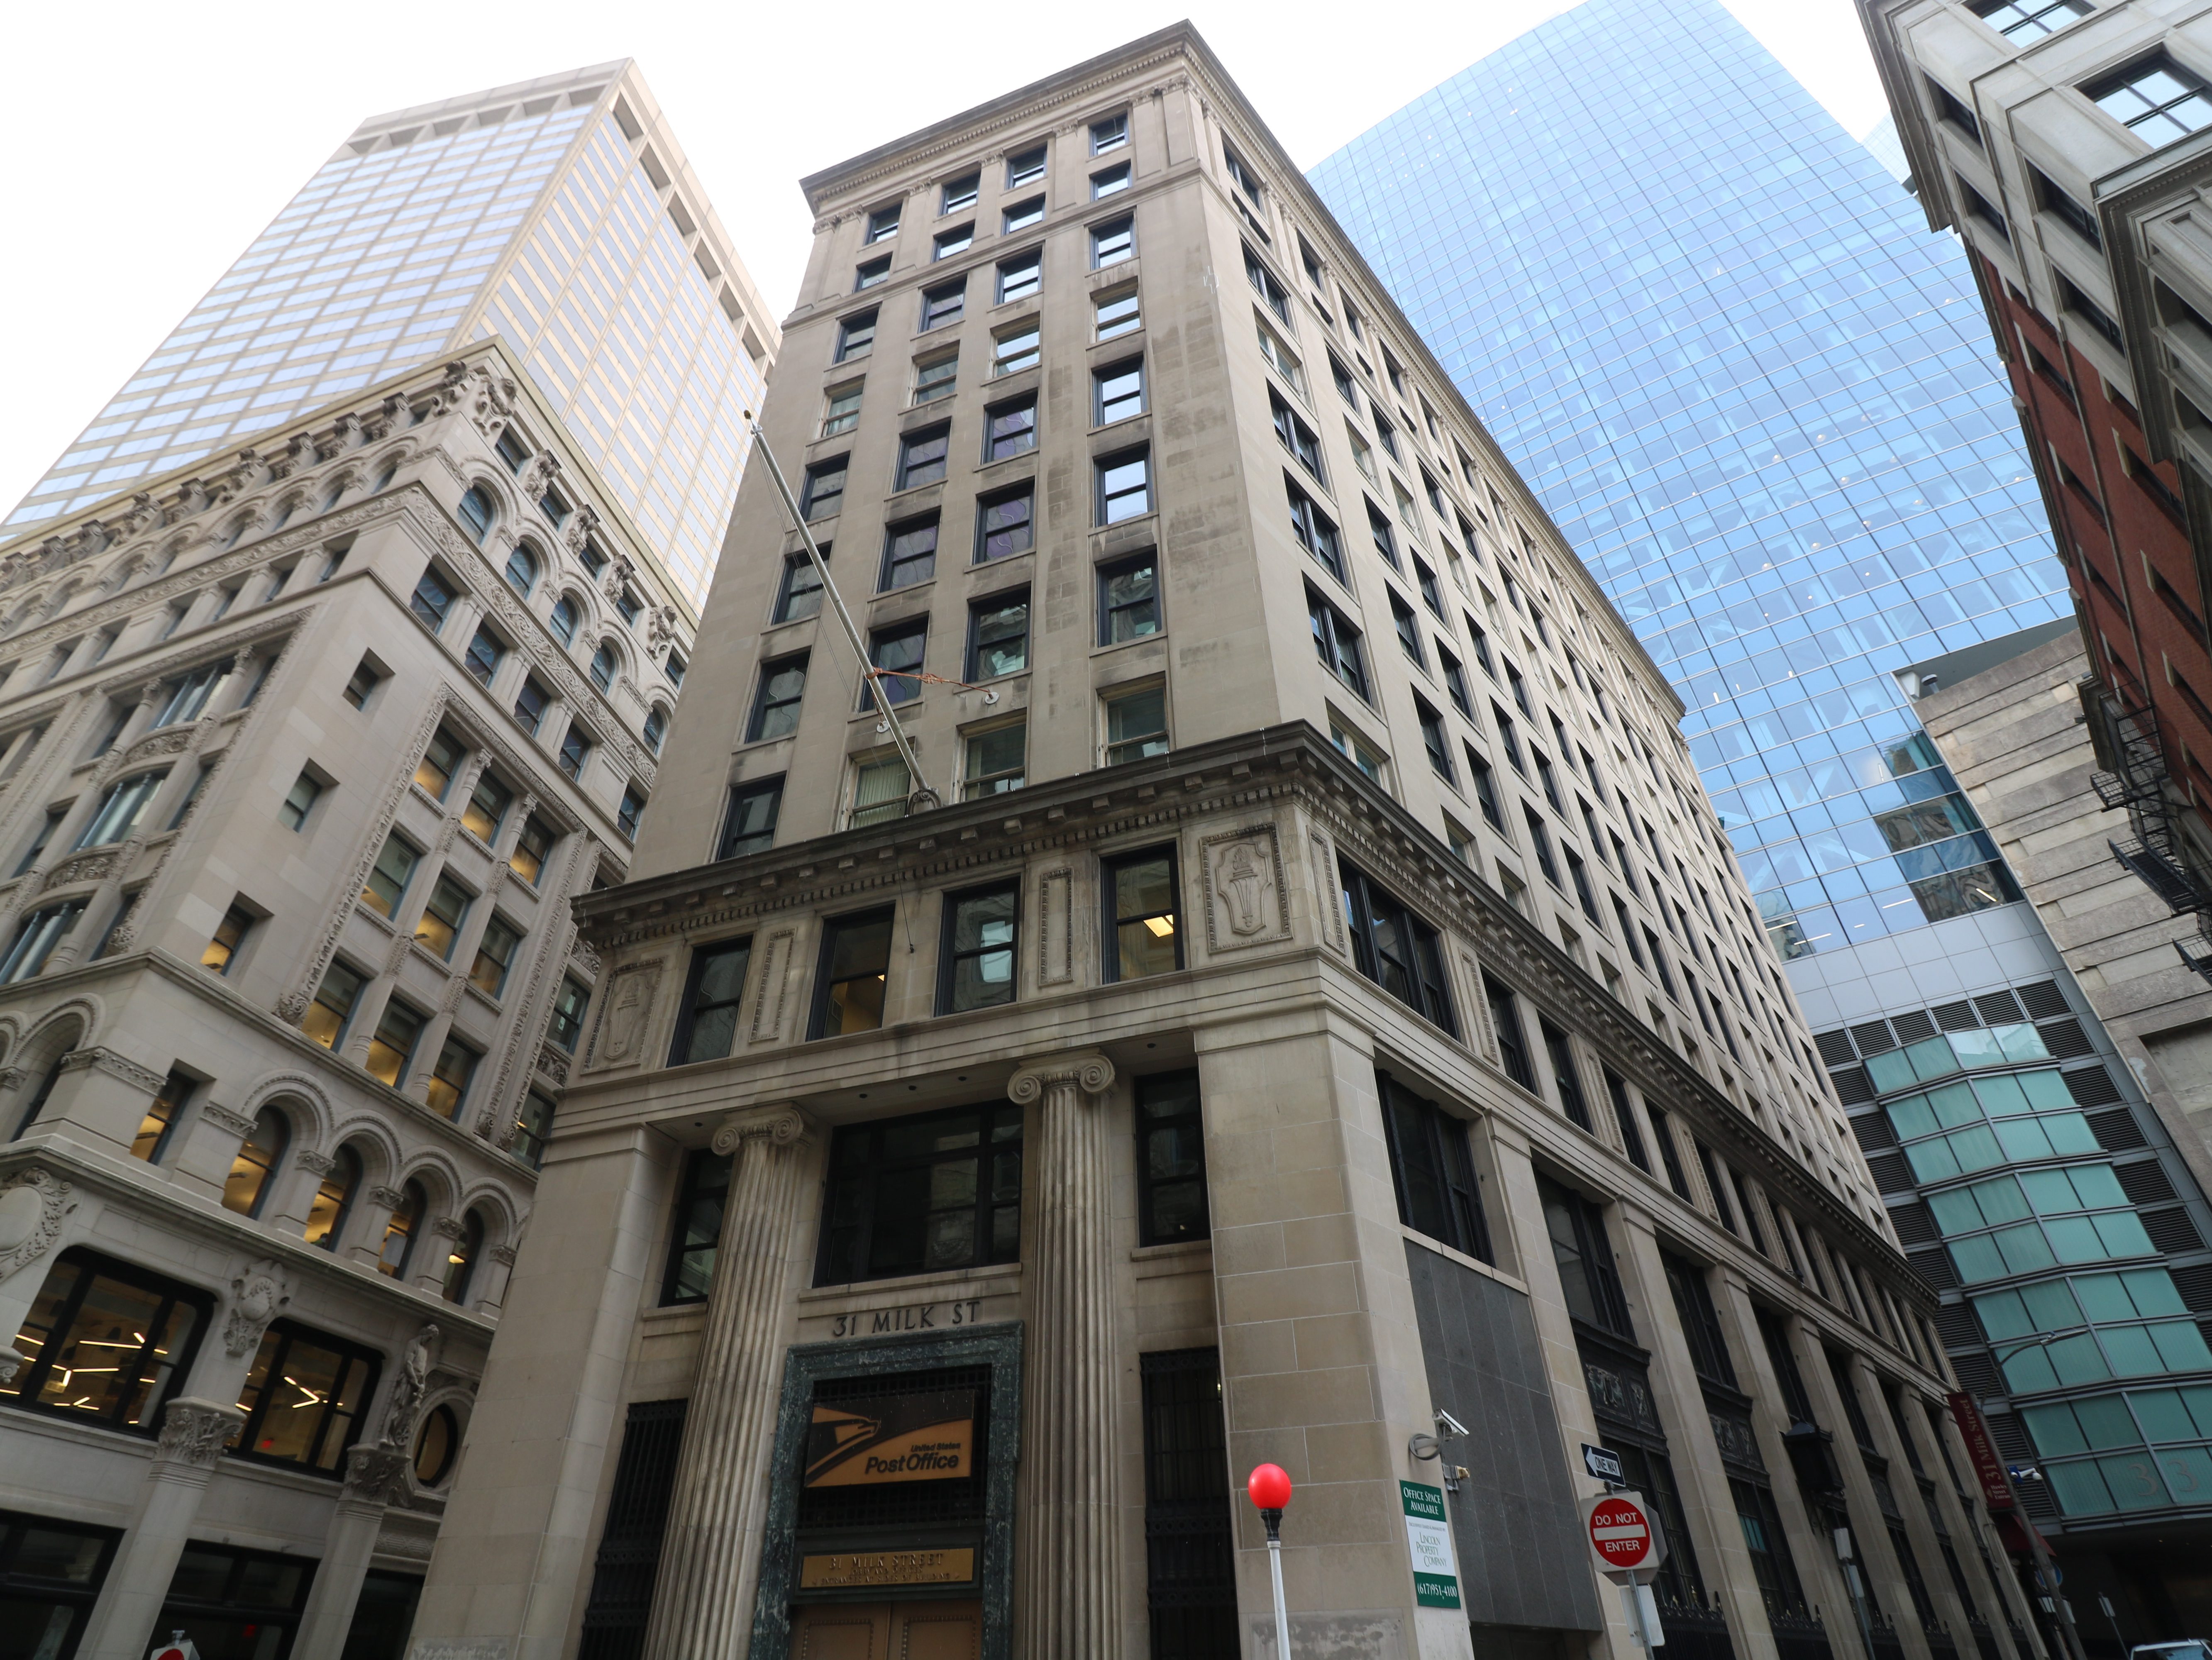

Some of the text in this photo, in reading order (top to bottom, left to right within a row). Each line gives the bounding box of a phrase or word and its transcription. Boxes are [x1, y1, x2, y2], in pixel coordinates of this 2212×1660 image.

[833, 1301, 981, 1337] 31 MILK ST
[911, 1443, 936, 1452] United
[1959, 1399, 2001, 1481] 31 Milk Street
[865, 1452, 959, 1474] Post Office
[1595, 1456, 1618, 1474] ONE WAY
[1403, 1487, 1441, 1504] OFFICE SPACE
[1411, 1500, 1439, 1515] AVAILABLE
[1595, 1512, 1637, 1526] DO NOT
[1419, 1531, 1440, 1545] LINCOLN
[1605, 1540, 1641, 1553] ENTER
[830, 1553, 943, 1569] 31 MILK STREET
